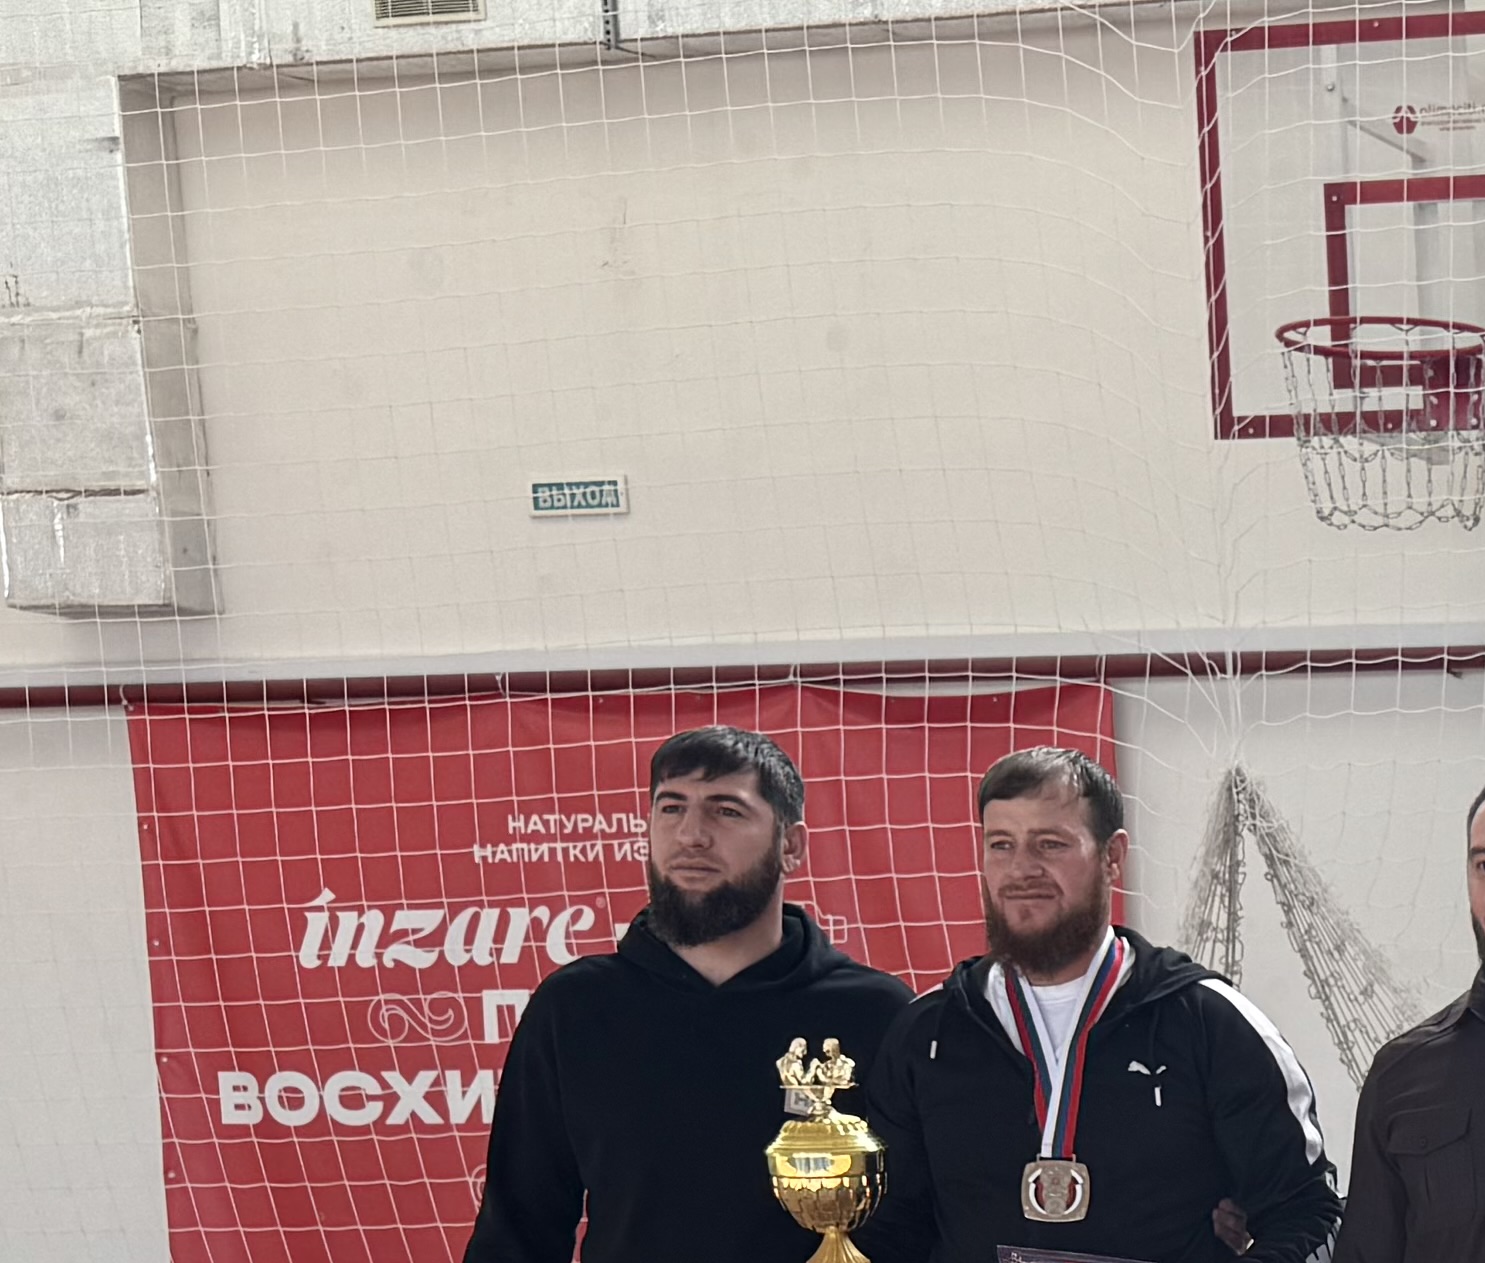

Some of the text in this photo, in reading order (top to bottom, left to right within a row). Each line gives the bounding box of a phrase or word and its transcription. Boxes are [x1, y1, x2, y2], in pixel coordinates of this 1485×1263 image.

[538, 485, 617, 508] ВЫХОД
[507, 813, 648, 834] НАТУРАЛЬ
[473, 840, 649, 864] НАПИТКИ ИЗ
[217, 1069, 501, 1127] ВОСХИ
